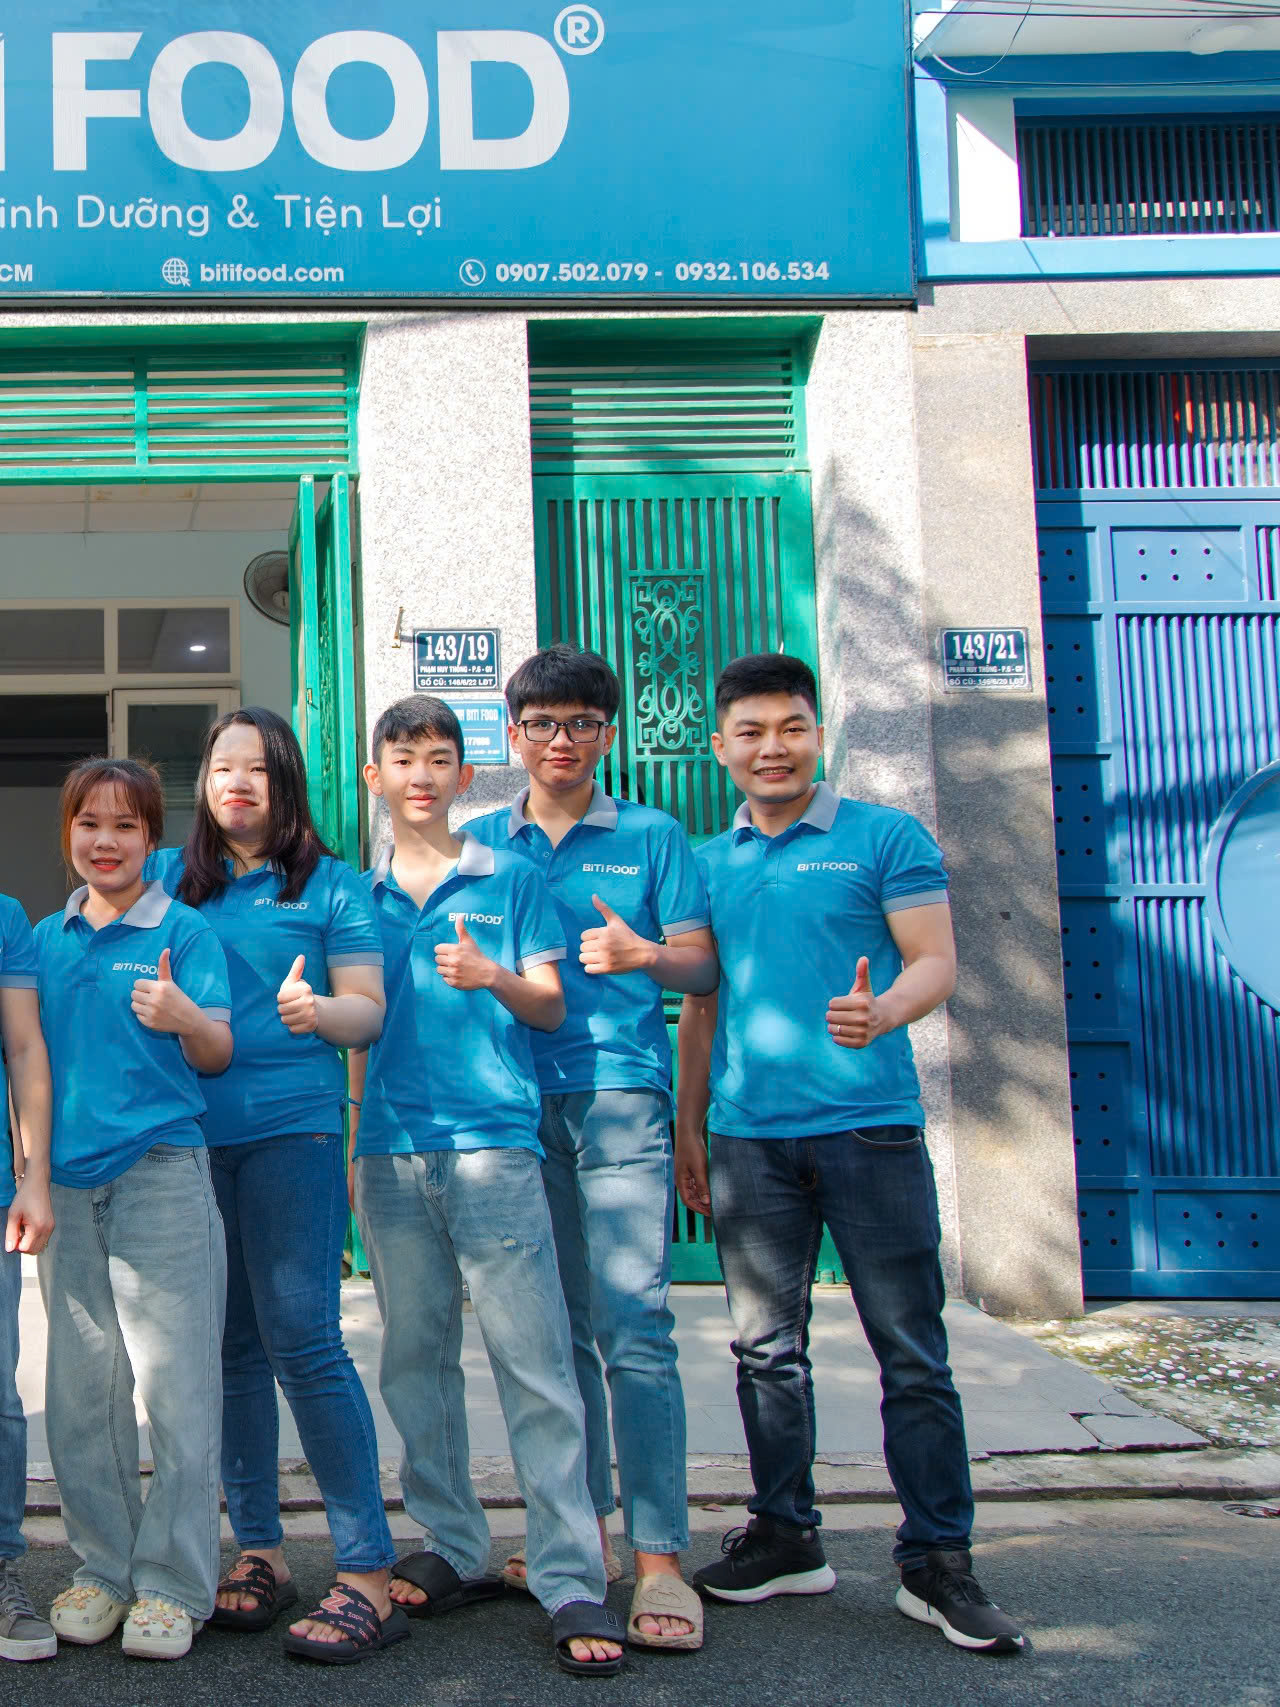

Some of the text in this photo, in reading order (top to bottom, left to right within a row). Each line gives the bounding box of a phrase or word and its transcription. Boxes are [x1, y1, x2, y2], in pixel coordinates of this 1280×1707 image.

[52, 30, 570, 172] FOOD
[77, 194, 209, 237] Dưỡng
[226, 193, 260, 229] &
[274, 194, 363, 237] Tiện
[381, 194, 441, 237] Lợi
[200, 263, 345, 282] bitifood.com
[496, 262, 649, 282] 0907.502.079
[675, 261, 830, 281] 0932.106.534
[425, 634, 489, 667] 143/19
[953, 633, 1018, 665] 143/21
[420, 677, 431, 686] SỐ
[582, 863, 638, 875] BITI FOOD
[796, 862, 858, 872] BITI FOOD
[469, 913, 502, 925] FOOD
[112, 962, 133, 971] BITI
